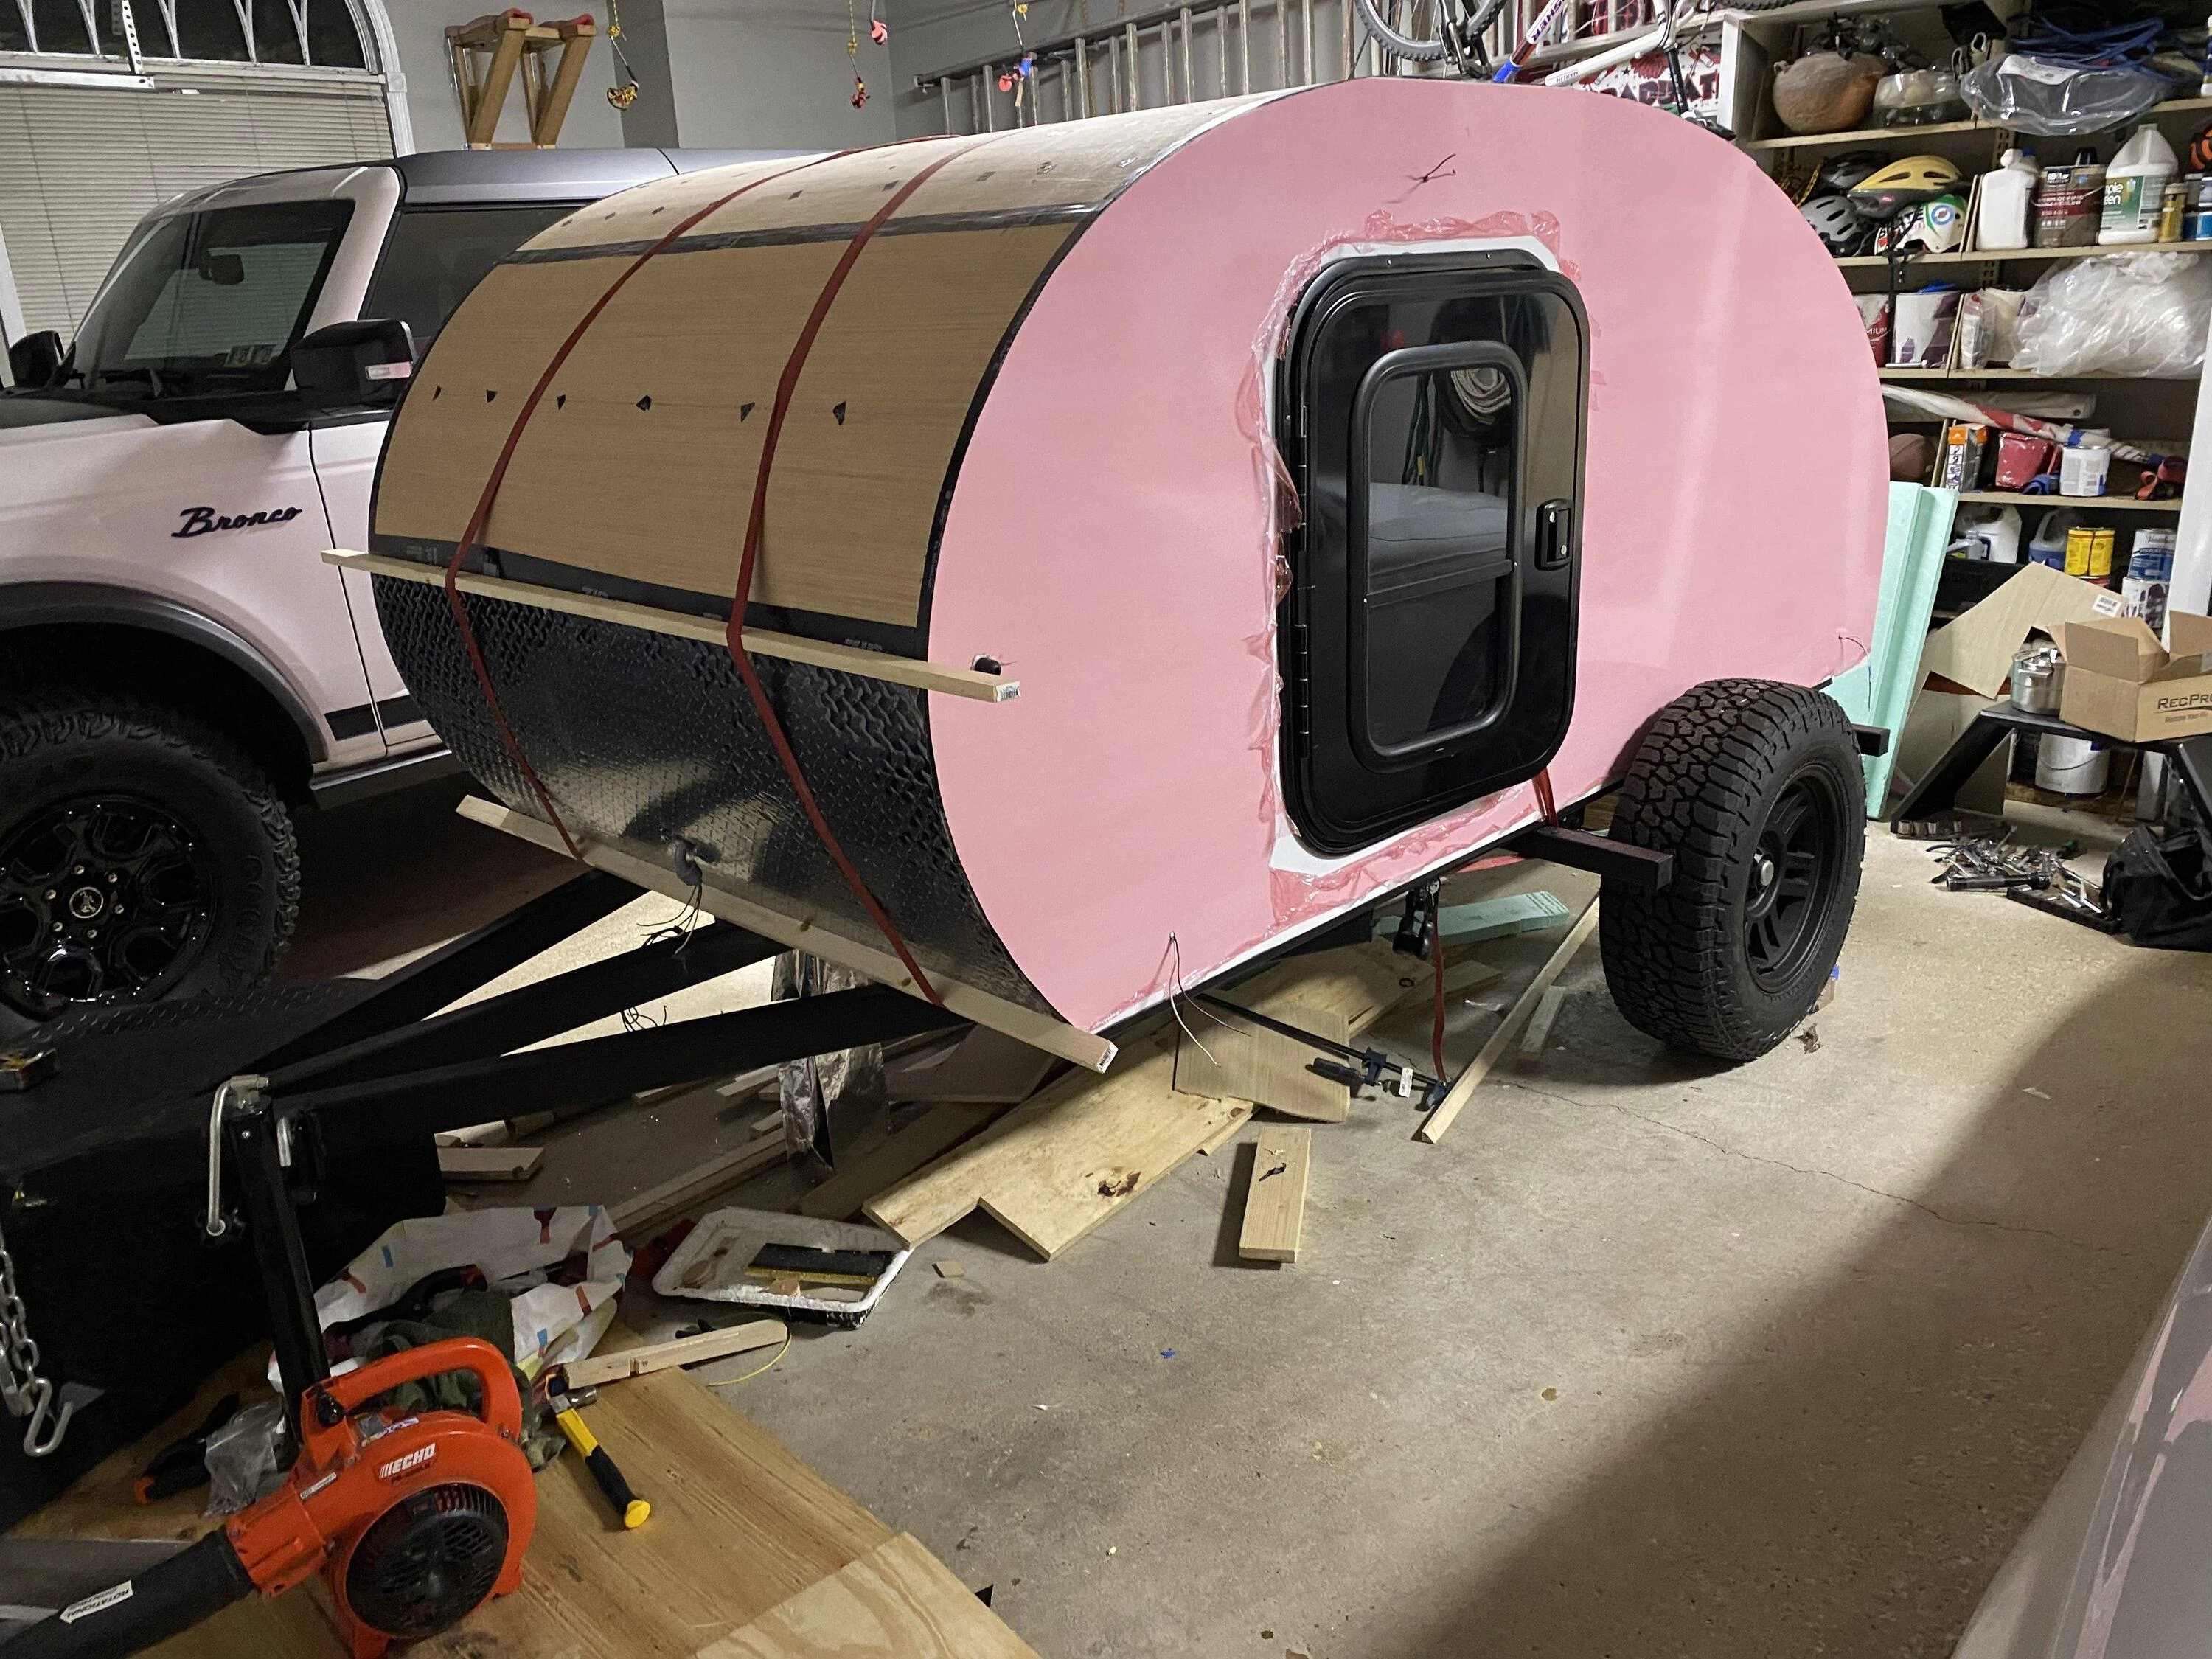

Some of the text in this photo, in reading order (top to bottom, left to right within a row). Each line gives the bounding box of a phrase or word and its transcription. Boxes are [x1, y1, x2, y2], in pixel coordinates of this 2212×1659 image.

[1531, 0, 1564, 41] SHER
[2103, 195, 2121, 206] een
[171, 506, 303, 538] Bronco
[2157, 693, 2212, 709] RECPR
[389, 1442, 436, 1475] ECHO
